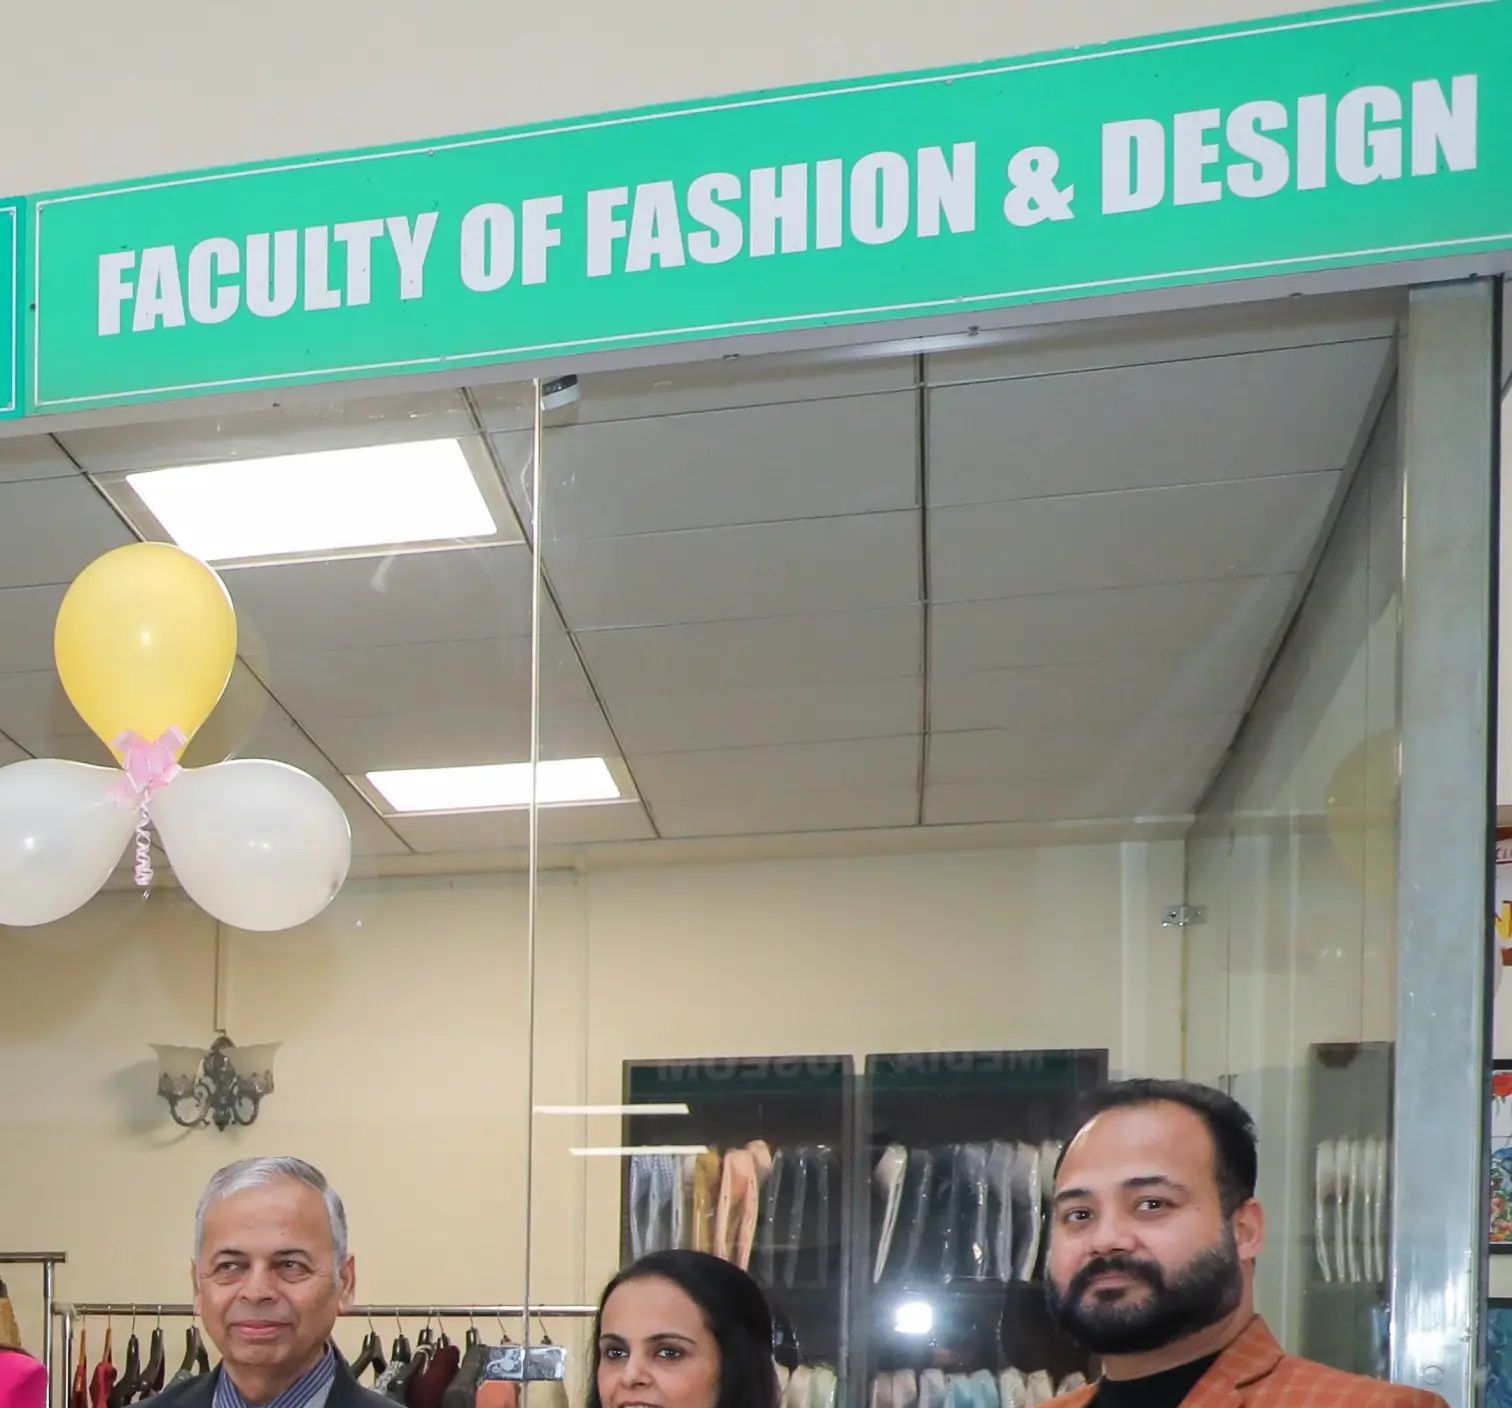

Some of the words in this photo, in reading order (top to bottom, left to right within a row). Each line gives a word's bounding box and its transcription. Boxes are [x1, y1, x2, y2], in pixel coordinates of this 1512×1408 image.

[98, 211, 439, 336] FACULTY
[460, 195, 563, 292] OF
[587, 142, 976, 277] FASHION
[1004, 146, 1074, 226] &
[1102, 74, 1477, 214] DESIGN
